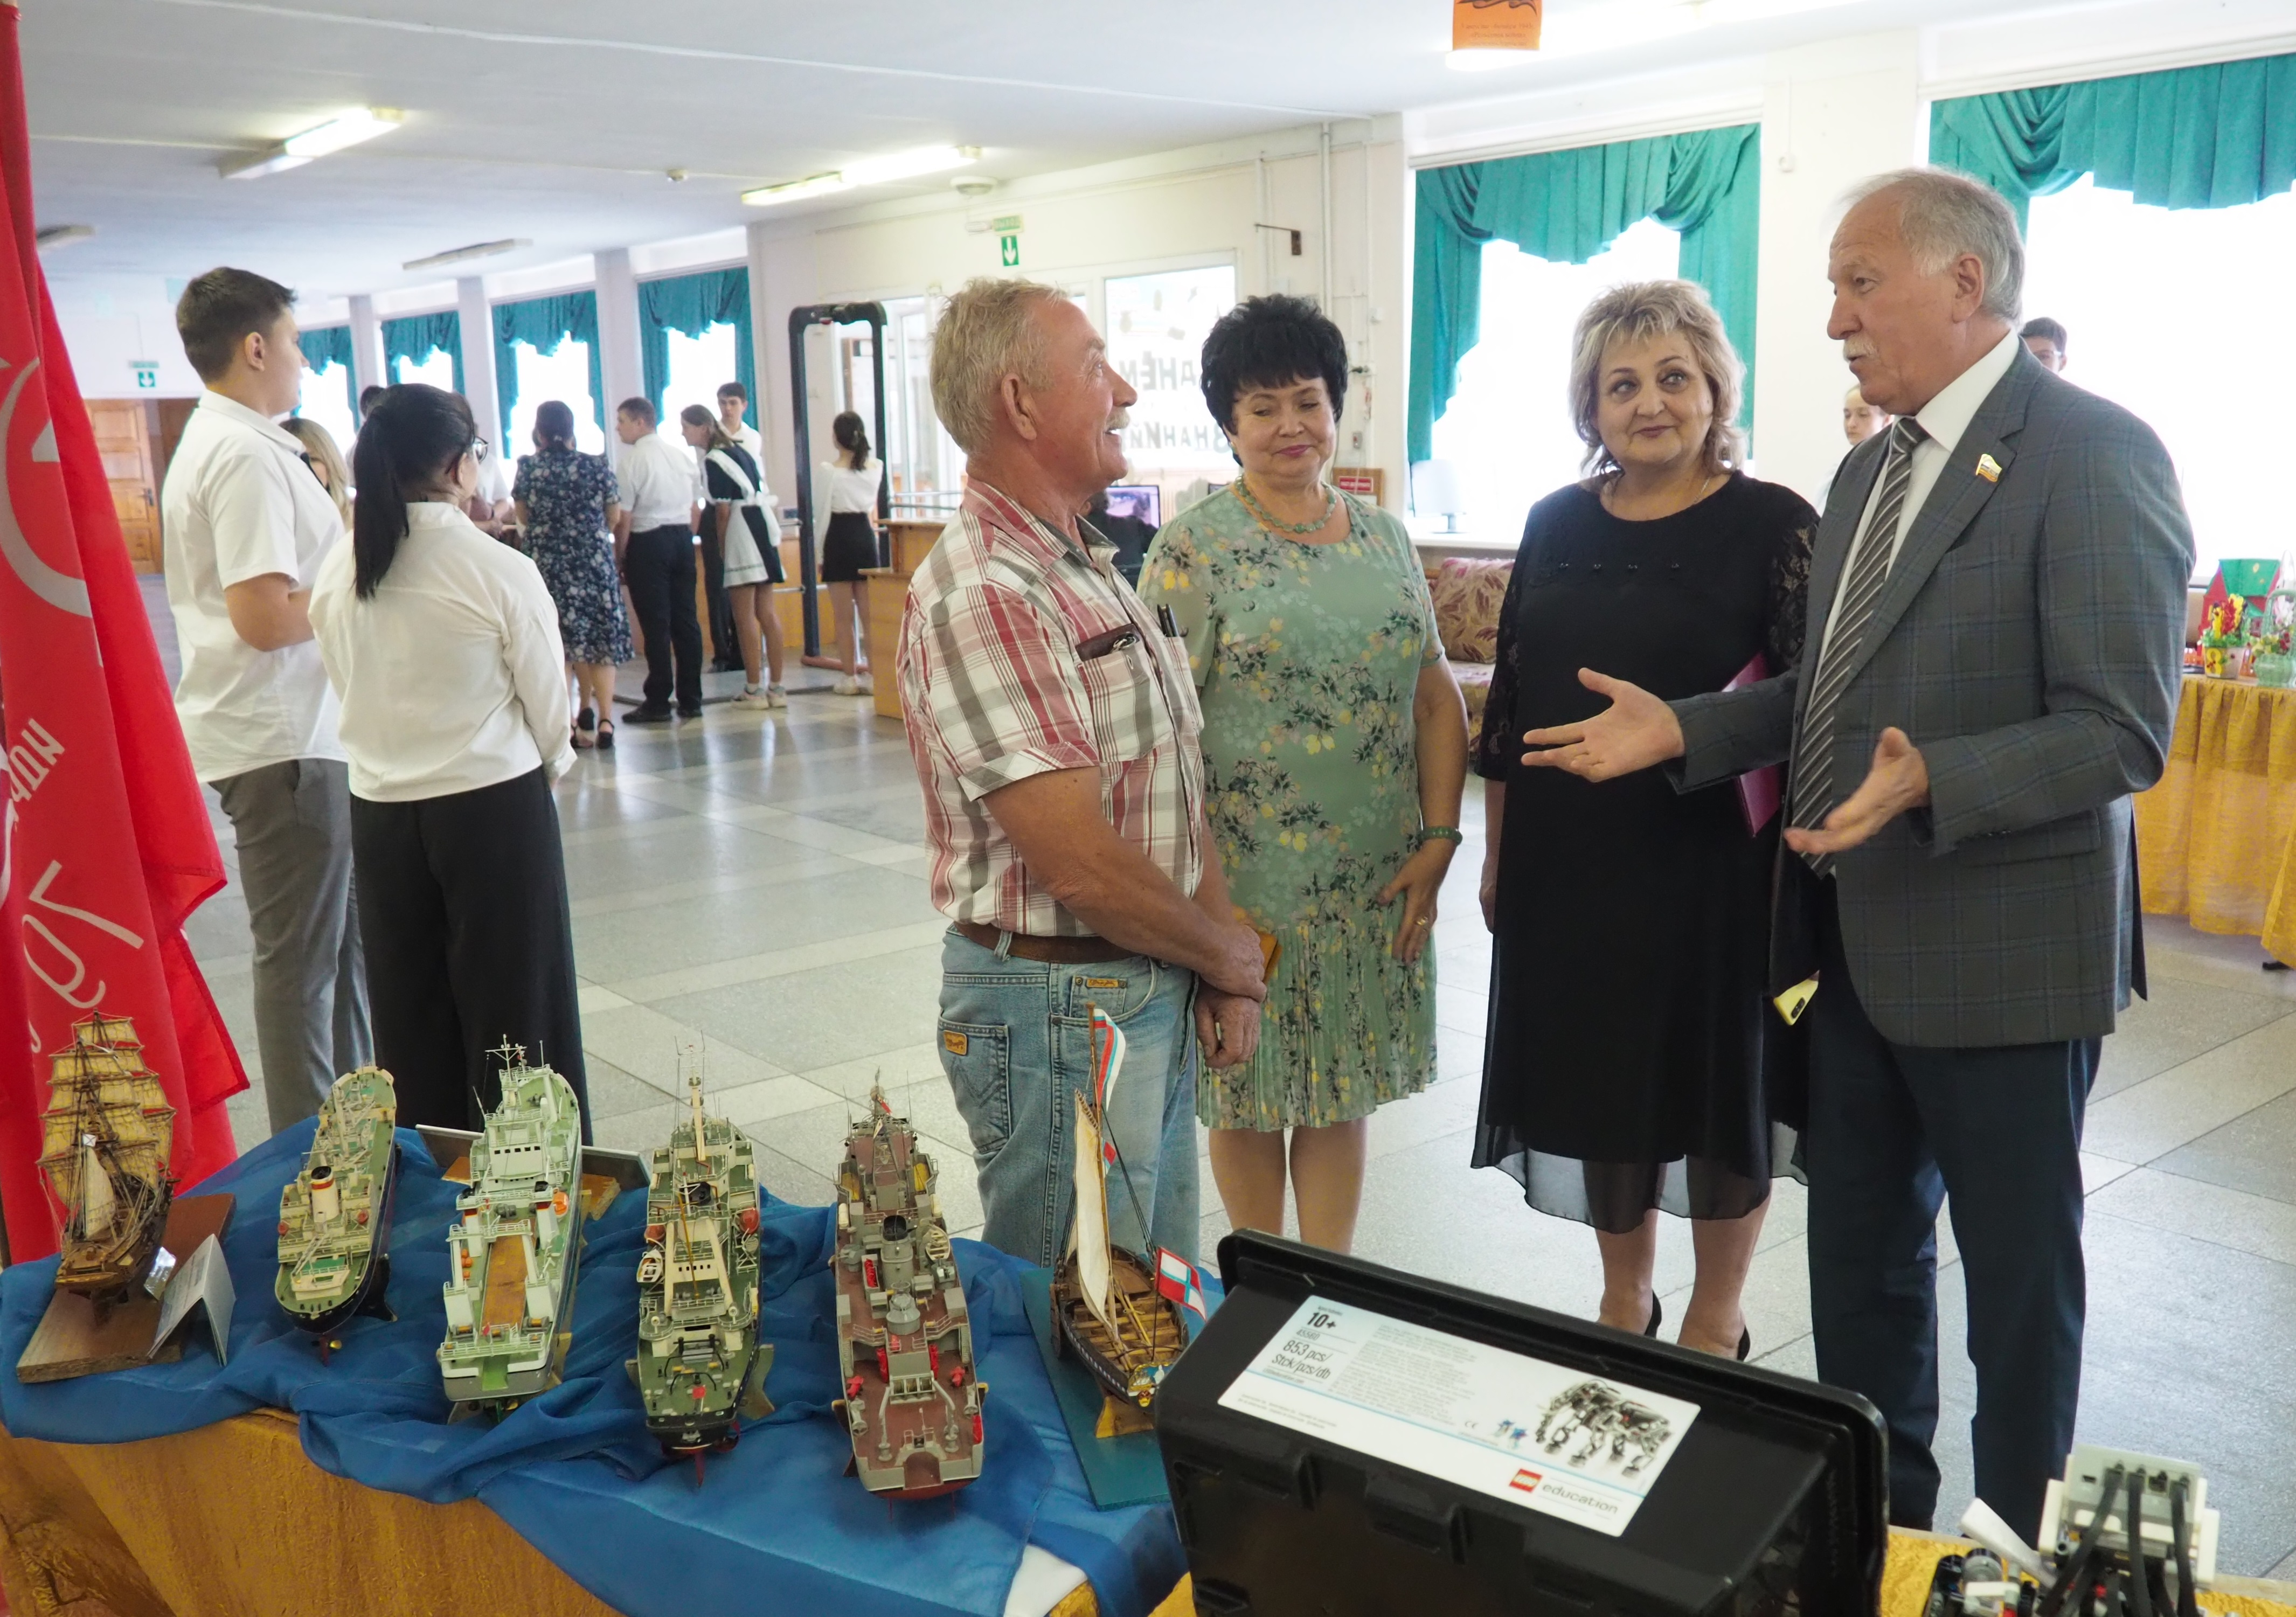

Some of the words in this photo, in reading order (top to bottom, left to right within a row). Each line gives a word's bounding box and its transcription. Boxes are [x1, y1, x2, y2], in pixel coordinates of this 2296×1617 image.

[1307, 1311, 1336, 1329] 10+
[1283, 1340, 1309, 1356] 853
[1305, 1349, 1333, 1363] pcs/
[1543, 1481, 1619, 1515] education
